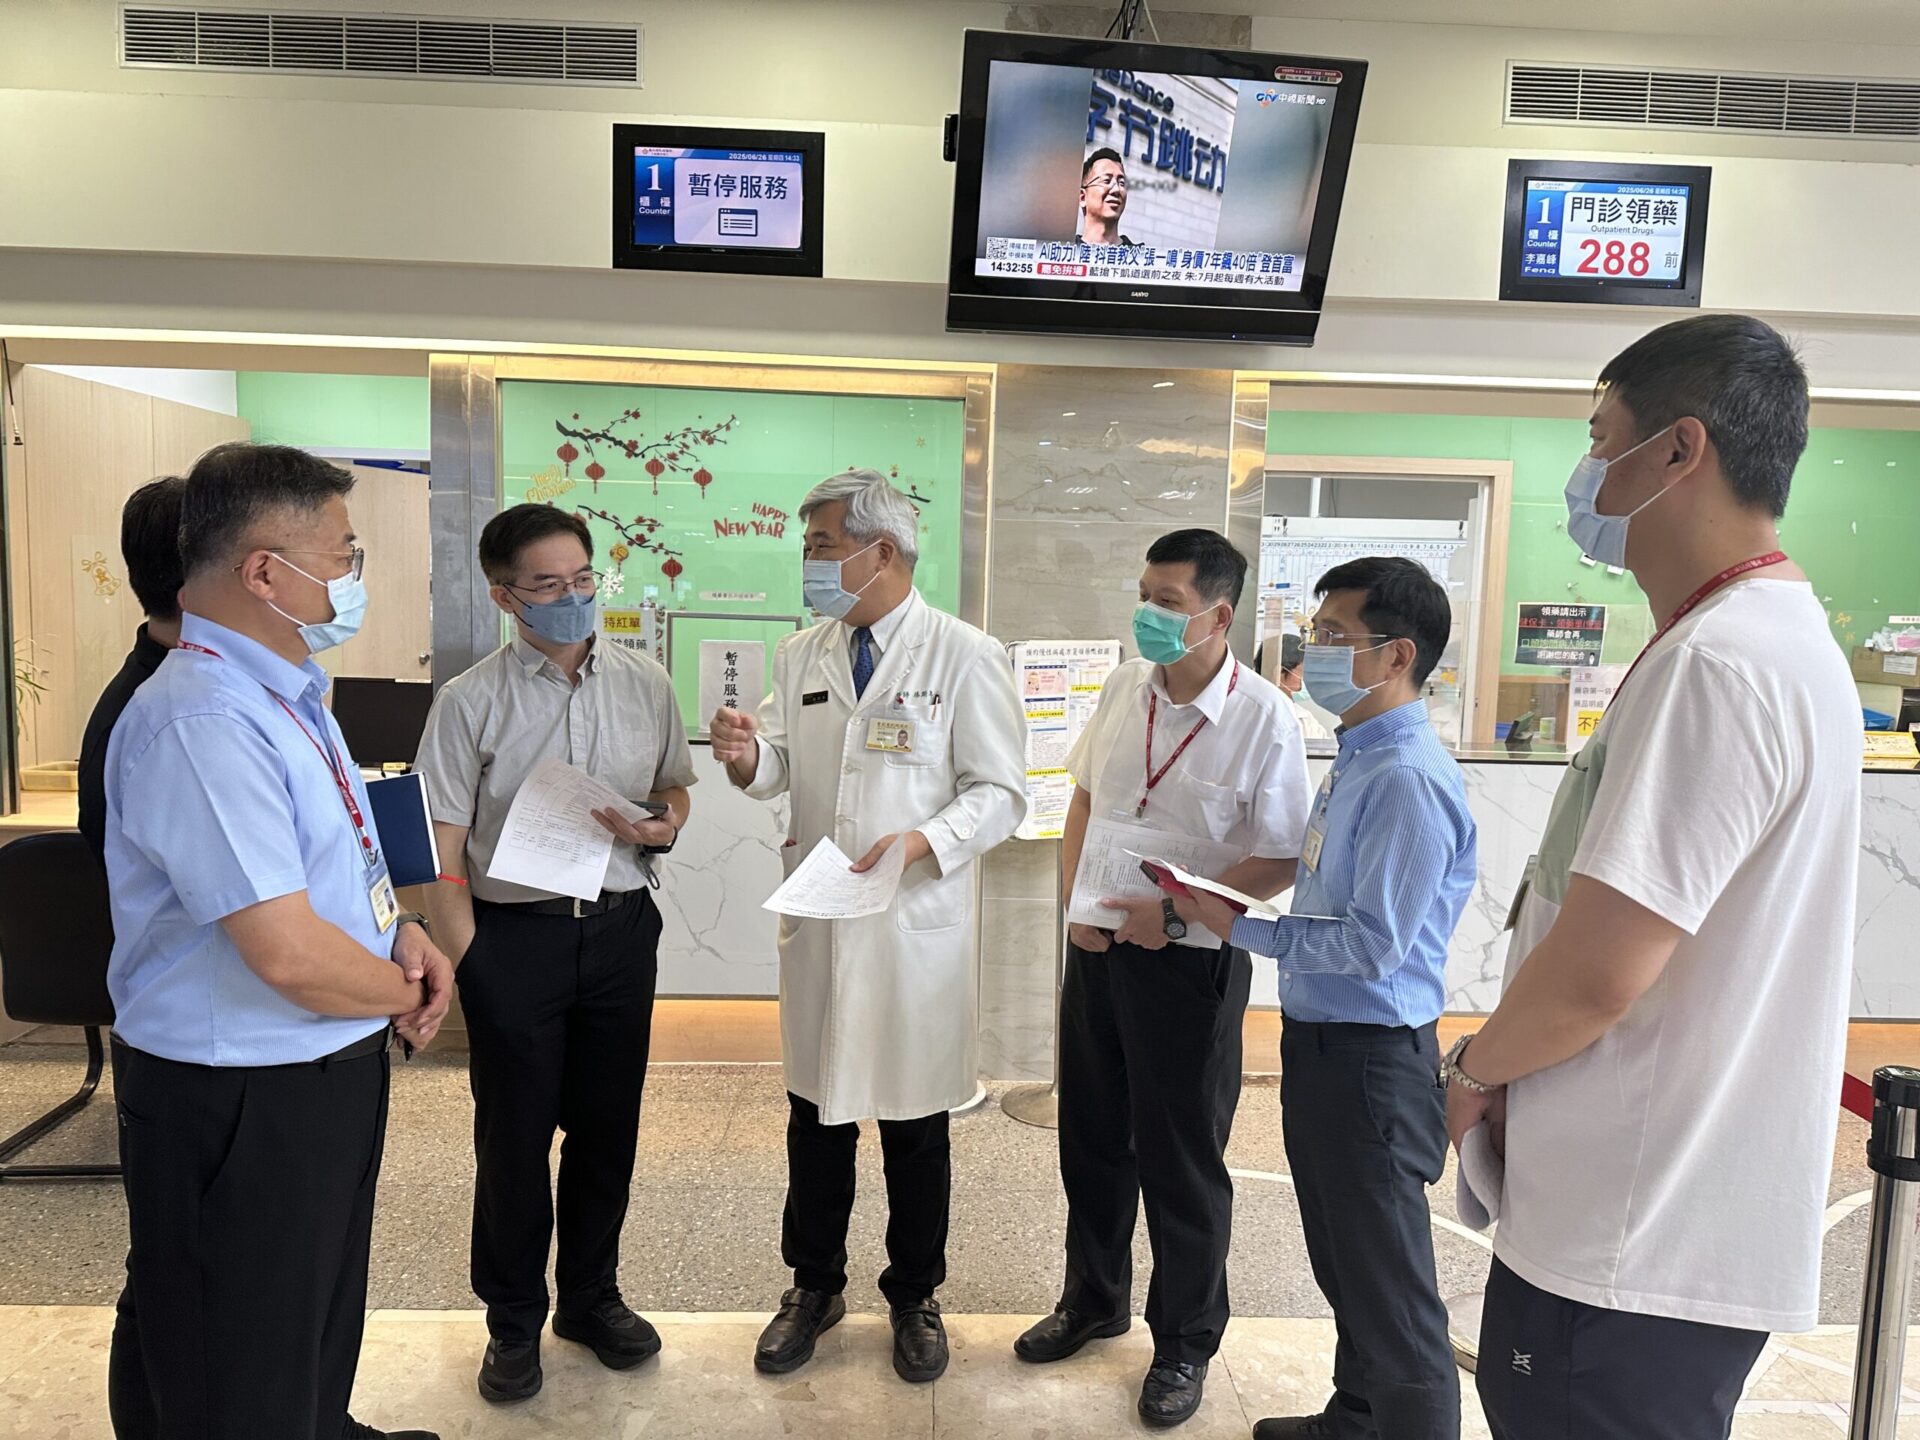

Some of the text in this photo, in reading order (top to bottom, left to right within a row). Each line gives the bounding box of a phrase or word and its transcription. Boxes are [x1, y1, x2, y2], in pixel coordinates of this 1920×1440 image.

[1279, 93, 1316, 105] 中視新聞
[647, 163, 663, 191] 1
[688, 173, 788, 200] 暫停服務
[639, 207, 671, 215] Counter
[1536, 197, 1552, 224] 1
[1570, 196, 1679, 225] 門診領藥
[1591, 225, 1654, 236] Outpatient Drugs
[1527, 240, 1558, 249] Counter
[1577, 239, 1679, 277] 288 前
[991, 262, 1032, 273] 14:32:55
[752, 502, 790, 522] HAPPY
[1541, 606, 1587, 616] 領藥請出示
[604, 617, 640, 628] 持紅單
[723, 651, 739, 709] 暫停服務
